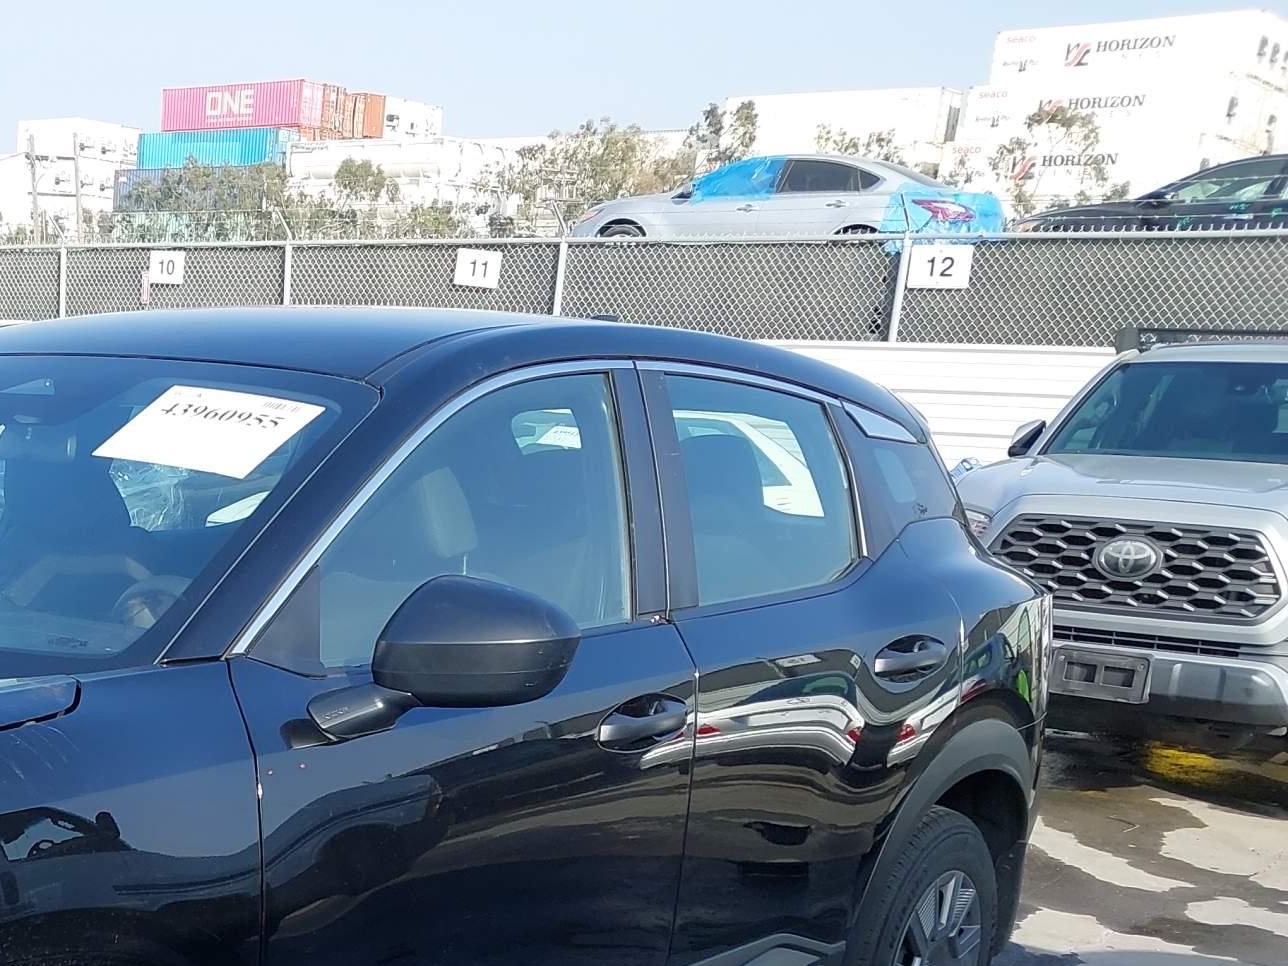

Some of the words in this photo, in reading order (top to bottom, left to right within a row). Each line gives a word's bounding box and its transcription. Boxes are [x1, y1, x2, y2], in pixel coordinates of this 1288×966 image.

[1095, 35, 1177, 53] HORIZON
[206, 89, 254, 116] ONE
[1068, 94, 1147, 111] HORIZON
[952, 146, 982, 154] seaco
[1041, 153, 1119, 167] HORIZON
[158, 260, 175, 276] 10
[468, 260, 490, 279] 11
[927, 256, 955, 277] 12
